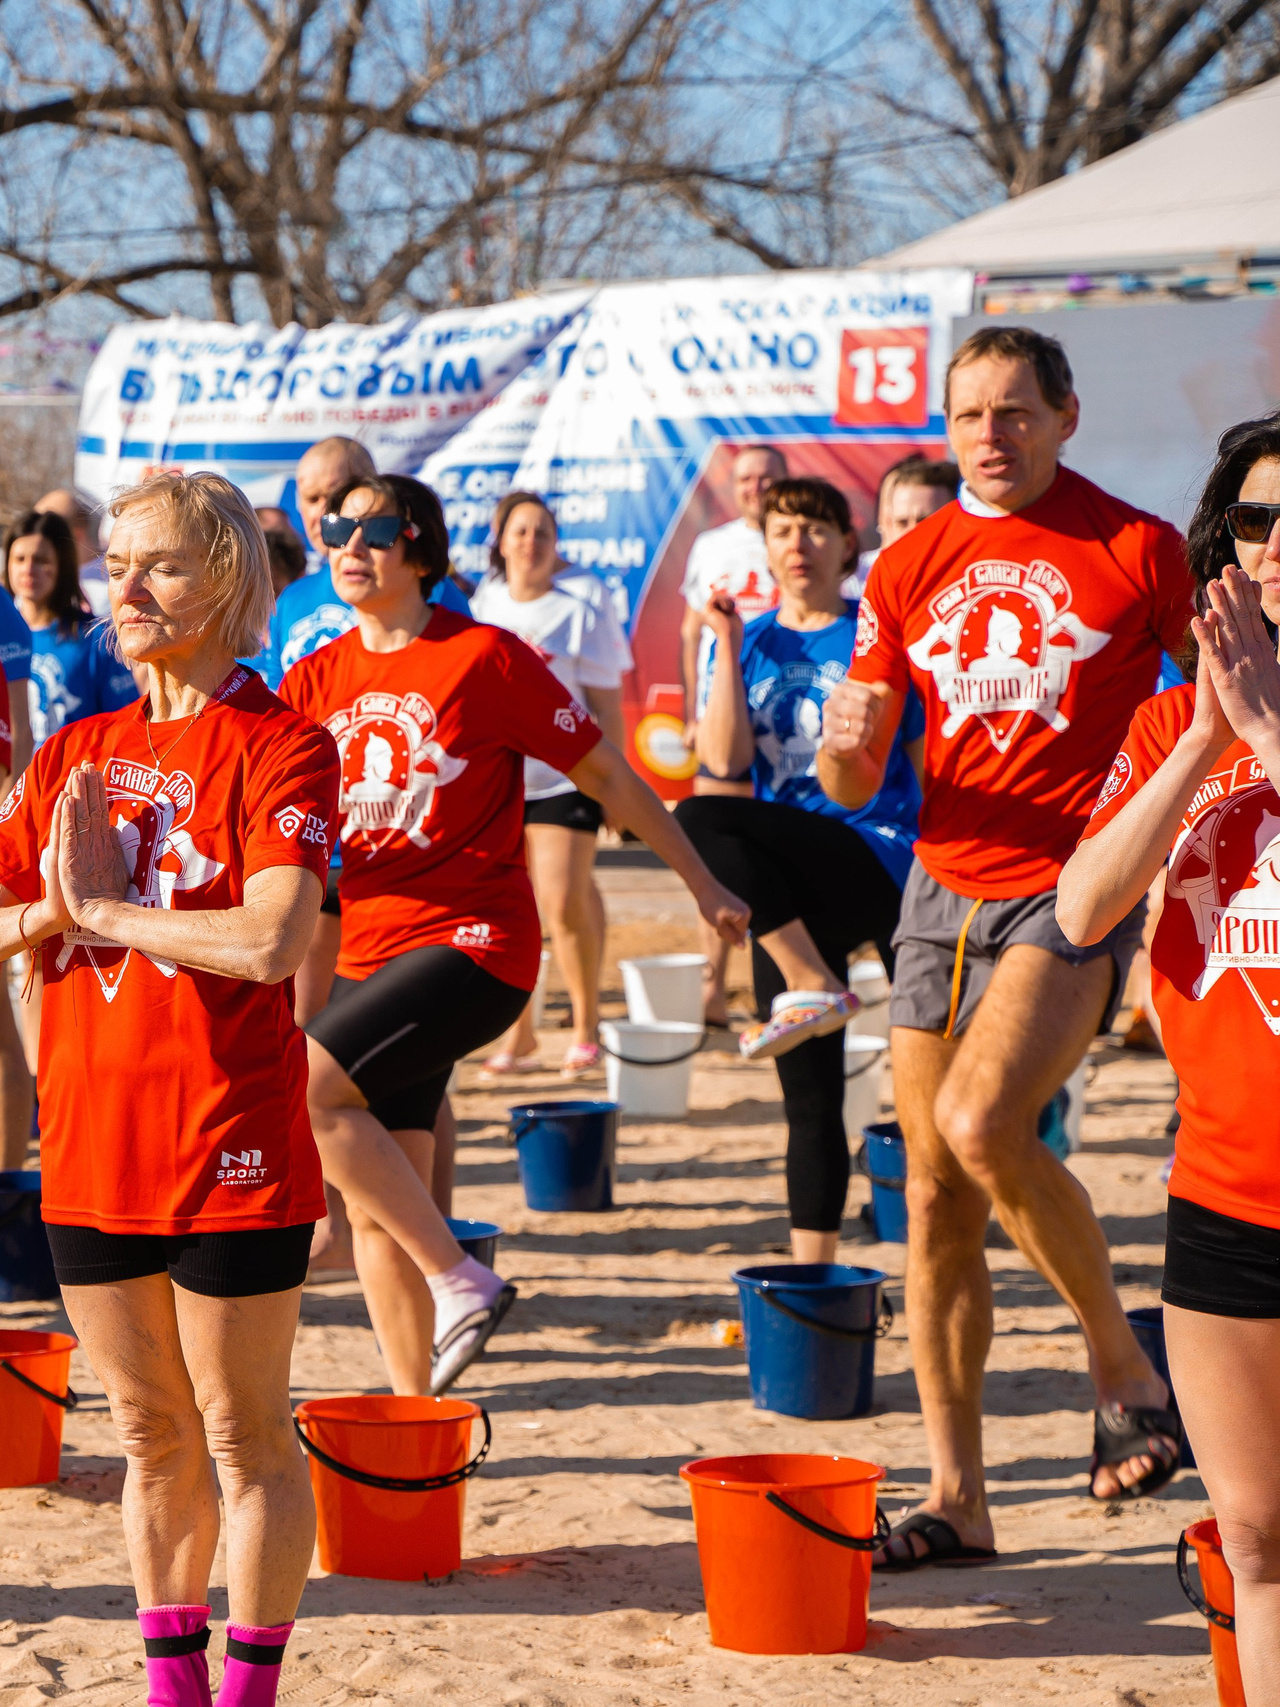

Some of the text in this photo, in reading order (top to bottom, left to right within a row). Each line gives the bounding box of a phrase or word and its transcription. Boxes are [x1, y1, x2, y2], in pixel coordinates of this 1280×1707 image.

[848, 346, 917, 405] 13
[974, 565, 1021, 587] СЛАВА
[110, 763, 159, 796] СЛАВА
[306, 812, 329, 831] ПУ
[301, 826, 328, 845] ДО
[1211, 911, 1279, 955] ЯРОП
[216, 1168, 268, 1179] SPORT
